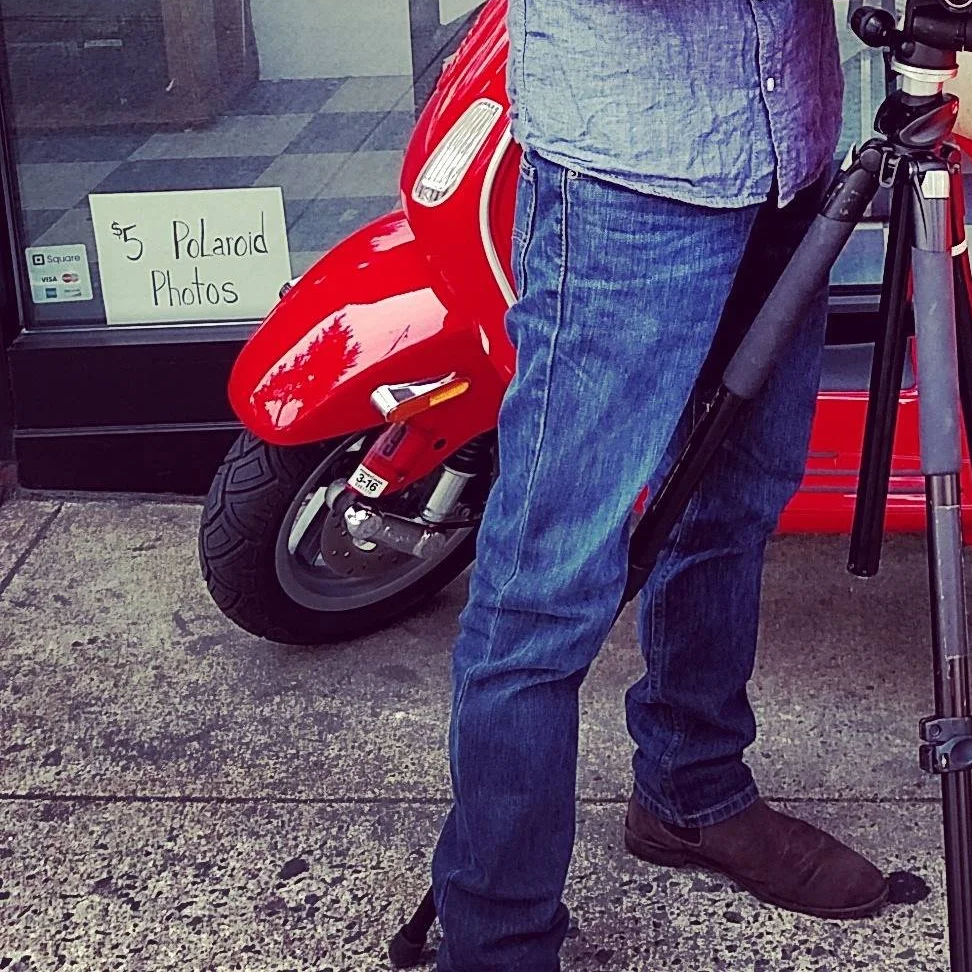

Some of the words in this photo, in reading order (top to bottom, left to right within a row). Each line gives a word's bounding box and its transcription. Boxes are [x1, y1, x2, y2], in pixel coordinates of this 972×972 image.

[111, 221, 143, 261] $5
[46, 254, 81, 265] Square
[41, 275, 58, 283] VISA
[151, 266, 239, 307] Photos
[355, 473, 379, 492] 3-16
